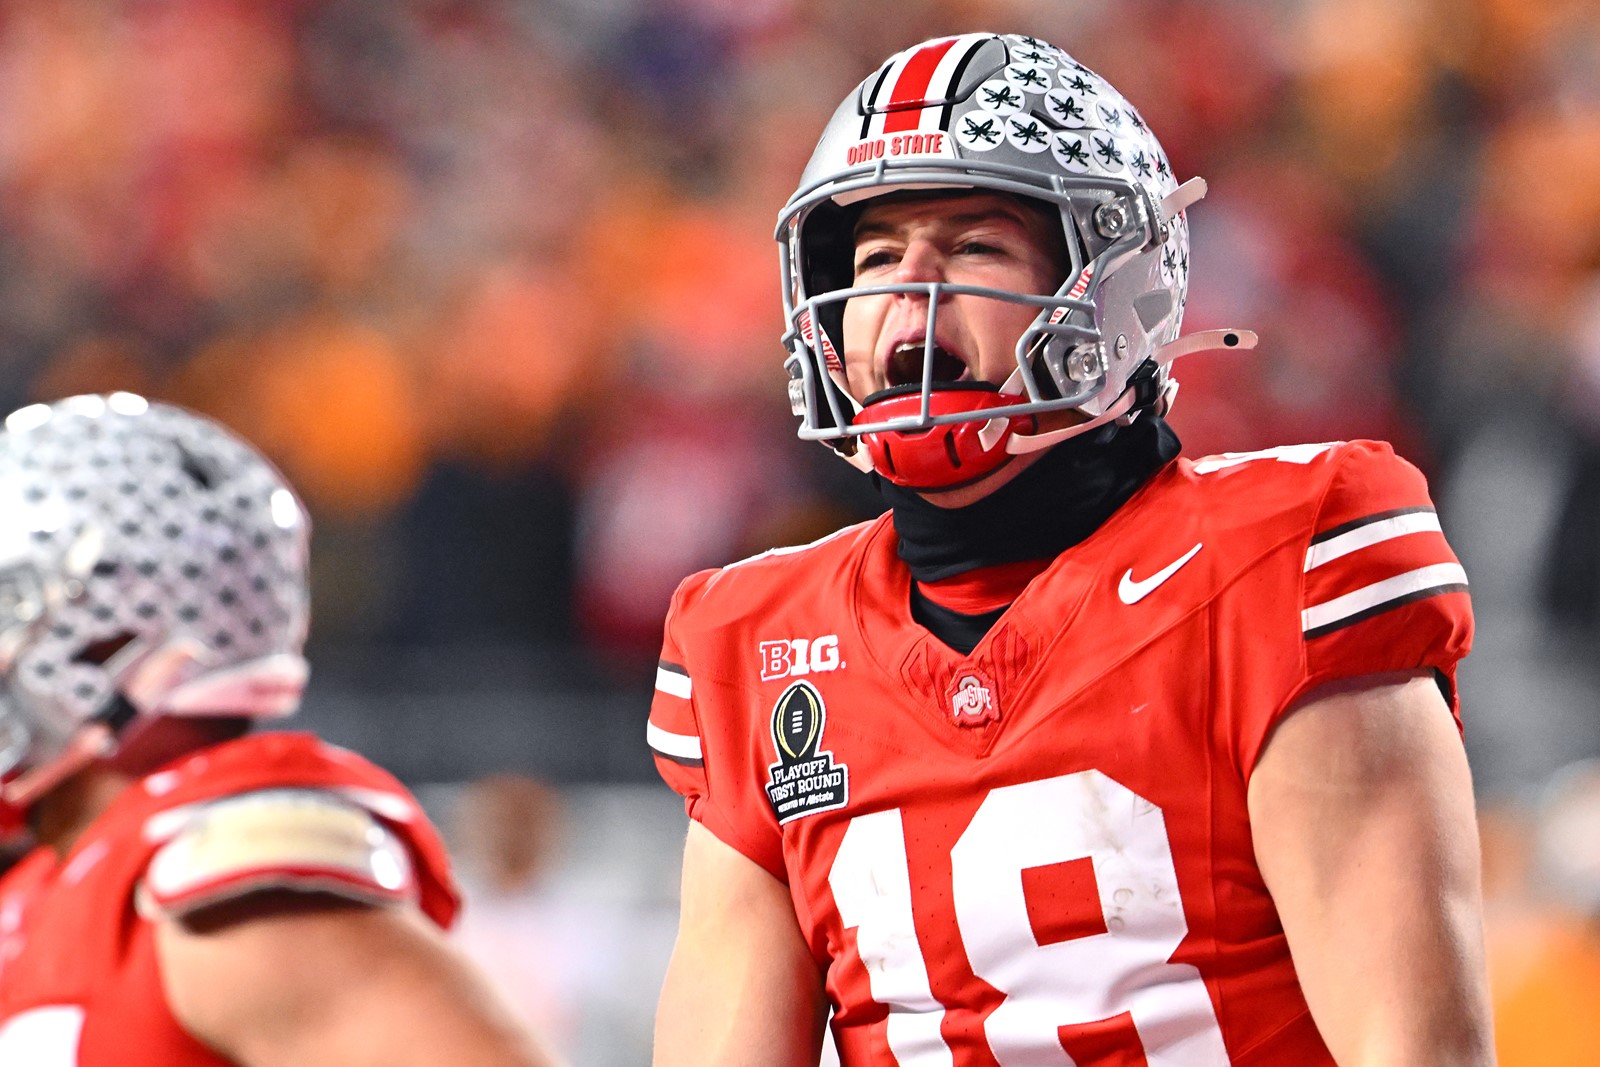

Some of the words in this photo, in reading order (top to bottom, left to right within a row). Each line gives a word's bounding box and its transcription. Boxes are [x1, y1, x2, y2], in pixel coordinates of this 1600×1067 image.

[846, 139, 885, 166] OHIO
[890, 134, 944, 156] STATE
[769, 782, 797, 804] FIRST
[796, 771, 842, 798] ROUND
[773, 760, 827, 785] PLAYOFF
[806, 791, 834, 806] Allstate
[828, 768, 1232, 1067] 18
